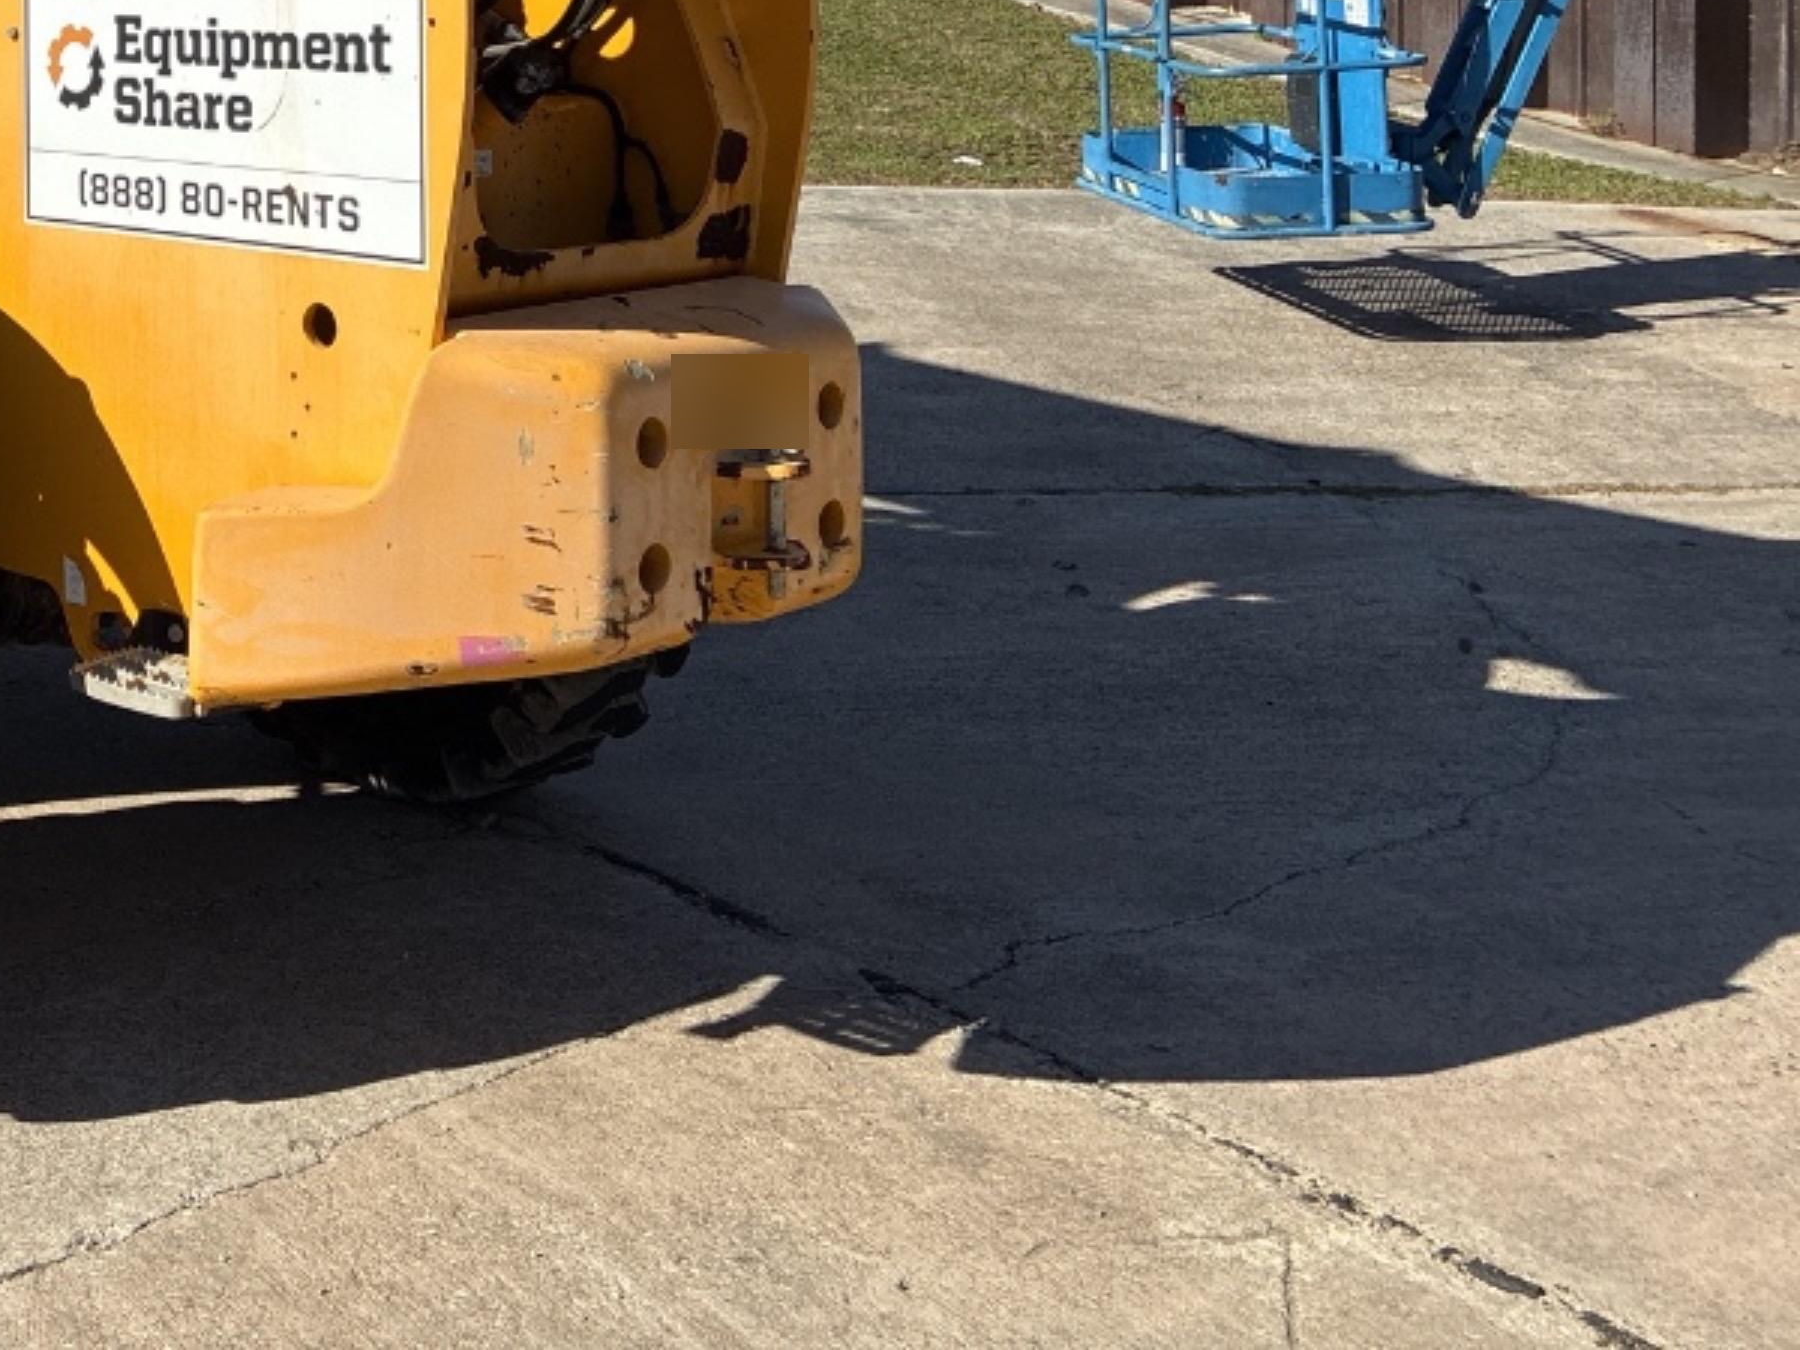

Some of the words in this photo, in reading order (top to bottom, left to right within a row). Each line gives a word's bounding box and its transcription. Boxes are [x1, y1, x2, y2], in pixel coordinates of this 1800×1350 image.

[114, 15, 391, 78] Equipment
[114, 77, 253, 132] Share
[80, 168, 167, 215] (888)
[181, 181, 360, 233] 80-RENTS
